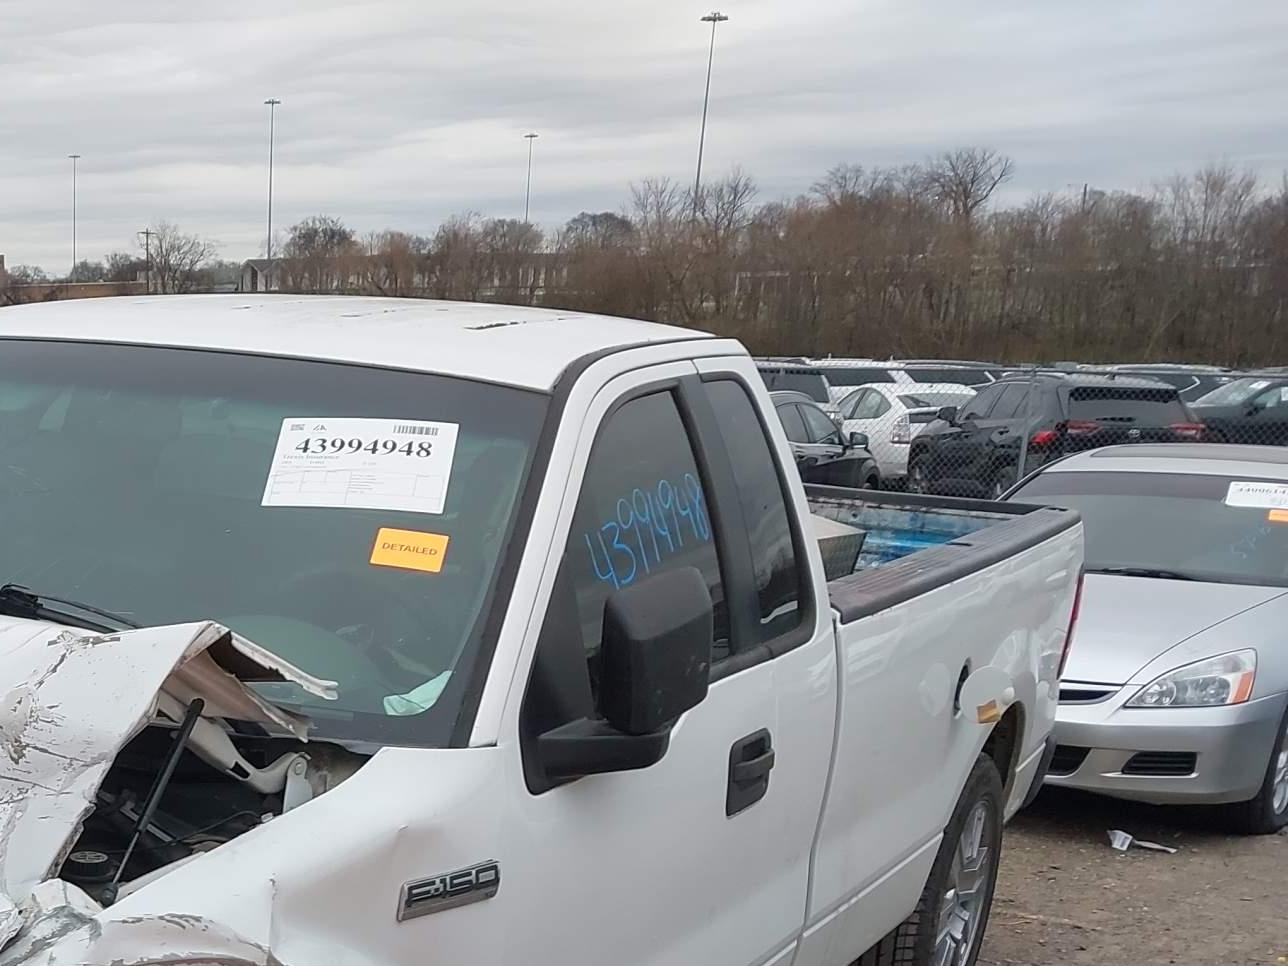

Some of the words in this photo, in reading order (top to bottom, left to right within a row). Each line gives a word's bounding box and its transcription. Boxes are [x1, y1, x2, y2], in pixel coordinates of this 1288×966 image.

[295, 438, 433, 458] 43994948
[583, 472, 710, 591] 43994948
[381, 542, 438, 556] DETAILED
